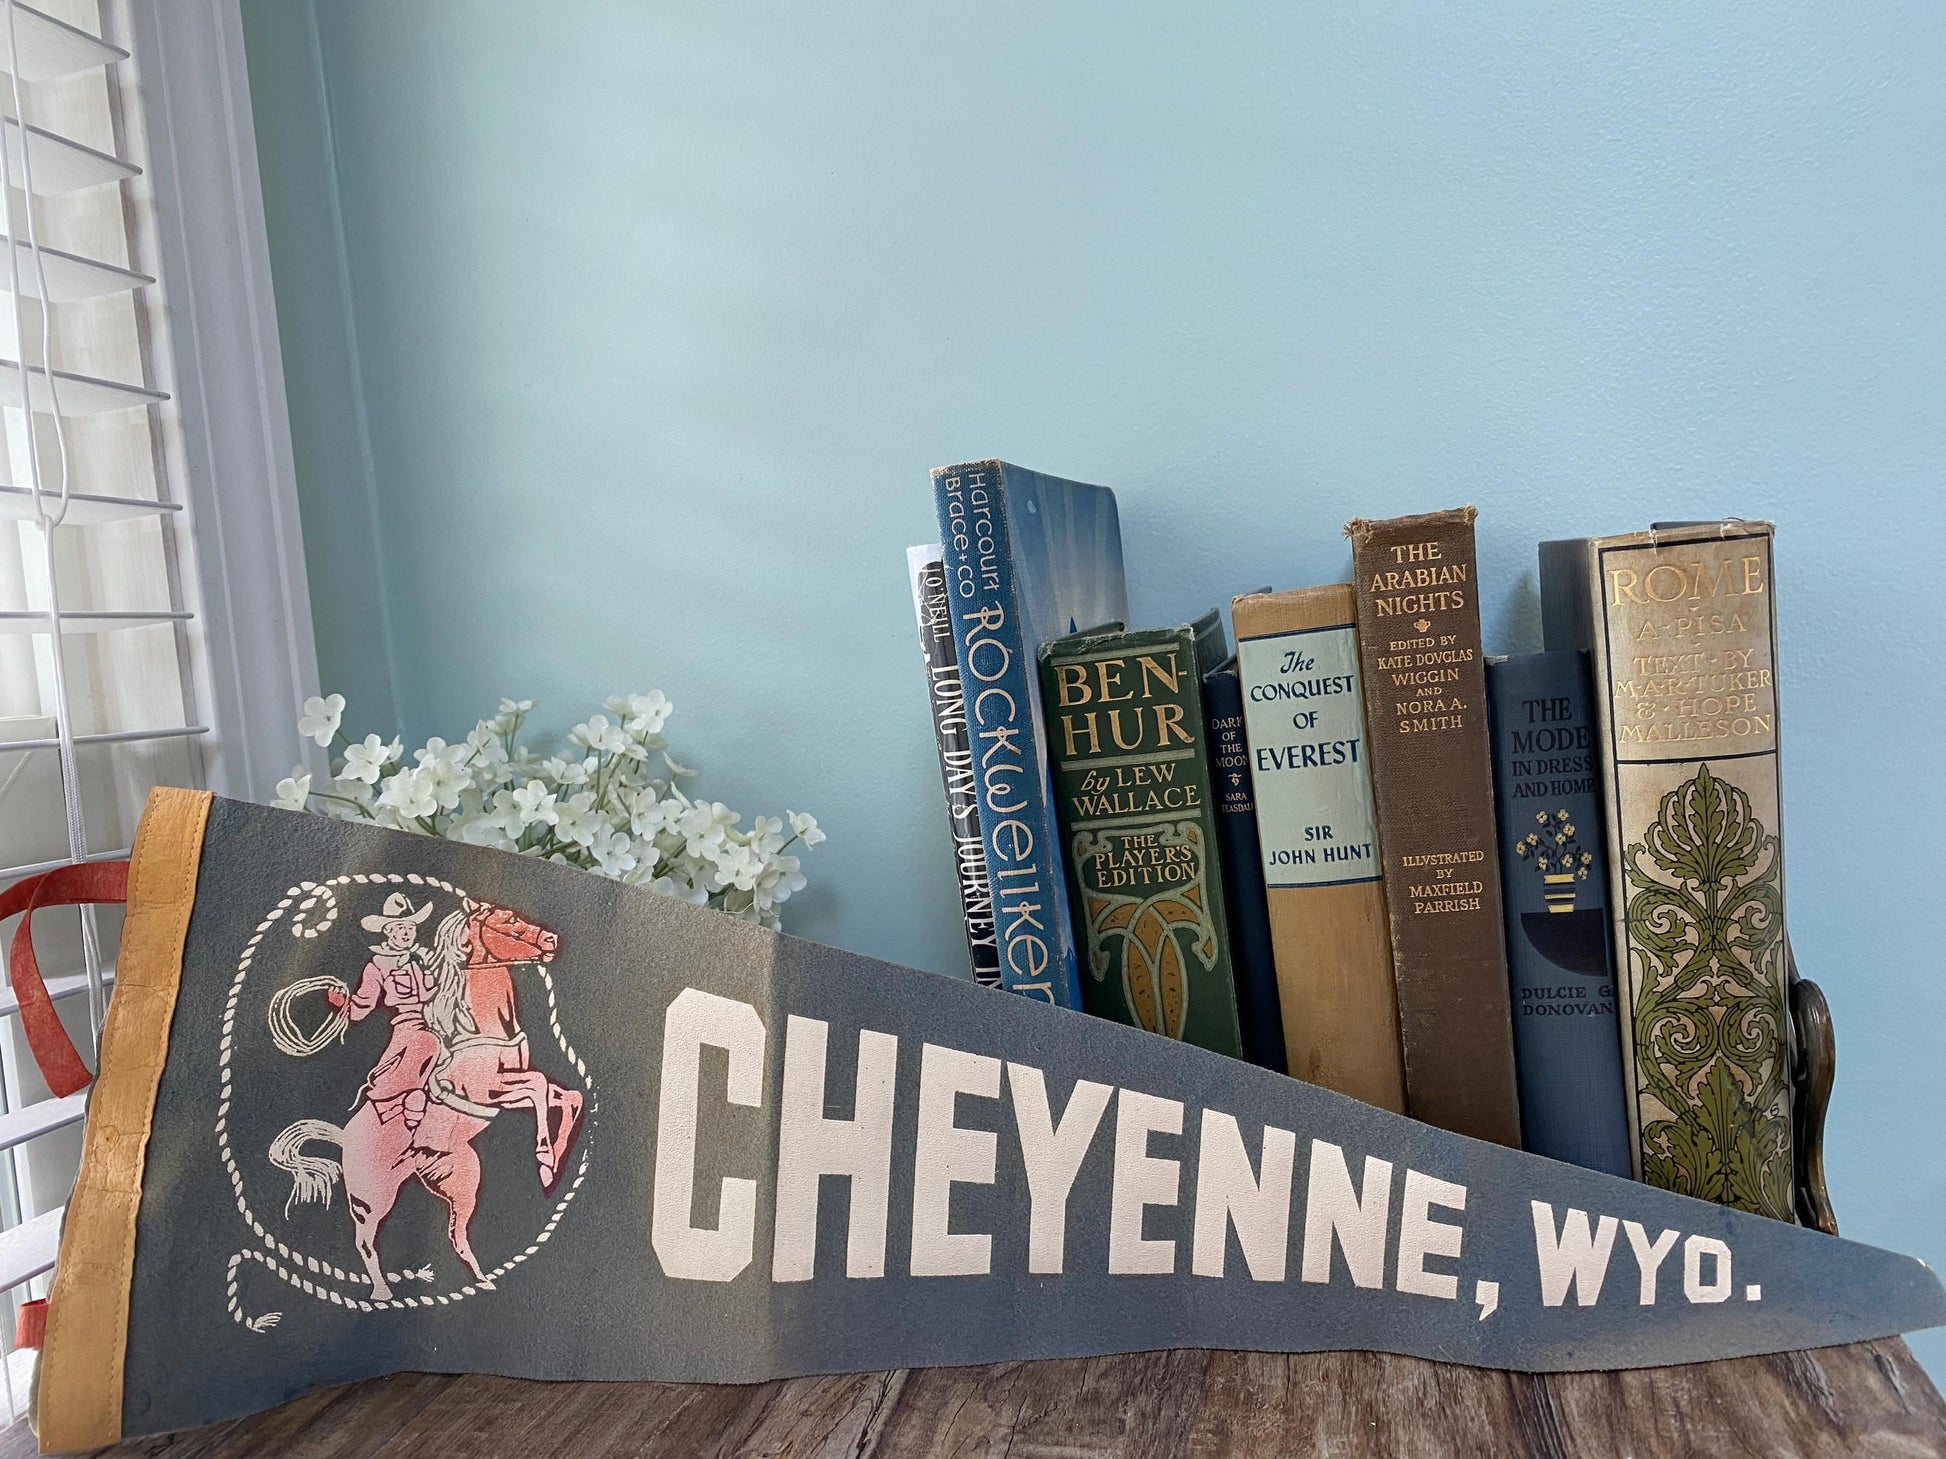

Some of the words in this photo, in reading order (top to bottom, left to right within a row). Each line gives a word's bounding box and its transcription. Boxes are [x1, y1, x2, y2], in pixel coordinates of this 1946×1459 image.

[969, 473, 1000, 590] Harcourt
[1391, 542, 1442, 563] THE
[1370, 564, 1467, 592] ARABIAN
[1608, 556, 1765, 606] ROME
[926, 577, 950, 643] O'NEILL
[1376, 590, 1464, 617] NIGHTS
[1390, 638, 1435, 651] EDITED
[1440, 635, 1456, 646] BY
[1280, 651, 1316, 674] The
[1377, 655, 1413, 670] KATE
[1633, 652, 1705, 676] TEXT
[1722, 648, 1755, 670] BY
[1054, 653, 1188, 707] BEN-
[1250, 675, 1354, 702] CONQUEST
[1391, 668, 1459, 686] WIGGIN
[931, 665, 968, 735] LONG
[1416, 687, 1442, 697] AND
[1396, 700, 1446, 715] NORA
[1449, 698, 1468, 711] A.
[1522, 697, 1573, 724] THE
[1636, 701, 1655, 720] &
[1677, 693, 1757, 718] HOPE
[1060, 704, 1196, 756] HUR
[1212, 716, 1243, 730] DARK
[1293, 711, 1318, 729] OF
[1399, 715, 1462, 733] SMITH
[1619, 715, 1771, 744] MALLESON
[1222, 732, 1236, 741] OF
[1510, 725, 1592, 754] MODE
[1220, 744, 1243, 754] THE
[1256, 739, 1360, 771] EVEREST
[1215, 755, 1248, 768] MOON
[1511, 761, 1532, 777] IN
[1536, 756, 1593, 775] DRESS
[944, 750, 978, 819] DAYS
[1080, 770, 1110, 795] by
[1115, 763, 1176, 787] LEW
[1511, 782, 1548, 798] AND
[1550, 778, 1595, 796] HOME
[1071, 785, 1201, 817] WALLACE
[1225, 793, 1247, 801] SARA
[1121, 835, 1158, 849] THE
[1304, 825, 1334, 841] SIR
[1095, 845, 1192, 870] PLAYER'S
[1269, 848, 1316, 866] JOHN
[1324, 843, 1371, 862] HUNT
[1097, 862, 1195, 888] EDITION
[1436, 868, 1454, 879] BY
[953, 832, 997, 947] JOURNEY
[1409, 881, 1483, 898] MAXFIELD
[1414, 898, 1481, 914] PARRISH
[1521, 987, 1587, 1000] DULCIE
[1523, 1003, 1615, 1016] DONOVAN
[651, 987, 1499, 1322] CHEYENNE,
[1531, 1200, 1761, 1307] WYO.
